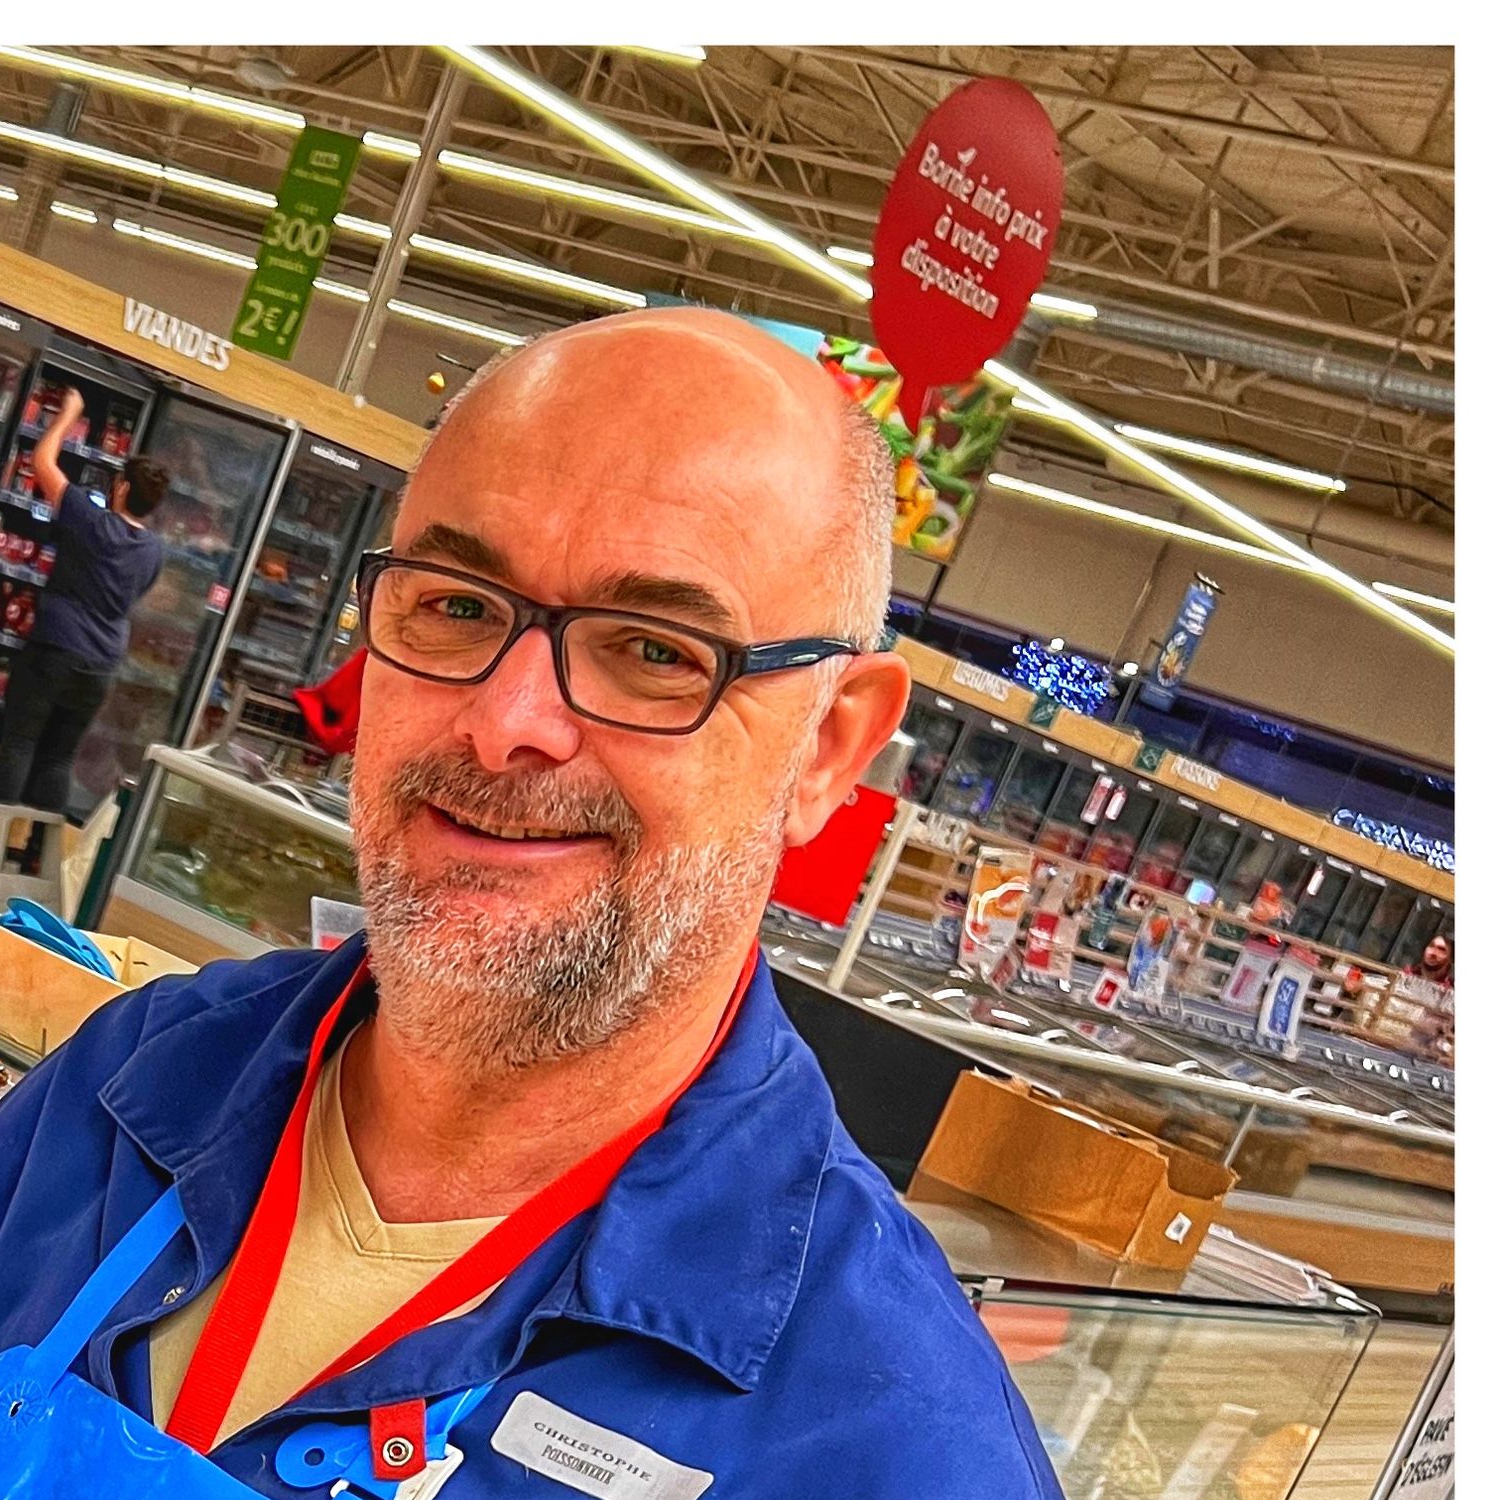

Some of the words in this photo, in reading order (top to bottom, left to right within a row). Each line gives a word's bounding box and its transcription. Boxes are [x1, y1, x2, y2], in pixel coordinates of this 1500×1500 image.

[918, 141, 975, 204] Borne
[971, 174, 1011, 226] info
[1003, 209, 1049, 251] prix
[266, 211, 328, 258] 300
[934, 203, 953, 241] à
[951, 220, 1000, 271] votre
[901, 238, 999, 320] disposition
[122, 297, 236, 372] VIANDES
[534, 1421, 652, 1482] CHRISTOPHE
[541, 1444, 615, 1486] POISSONNERIE
